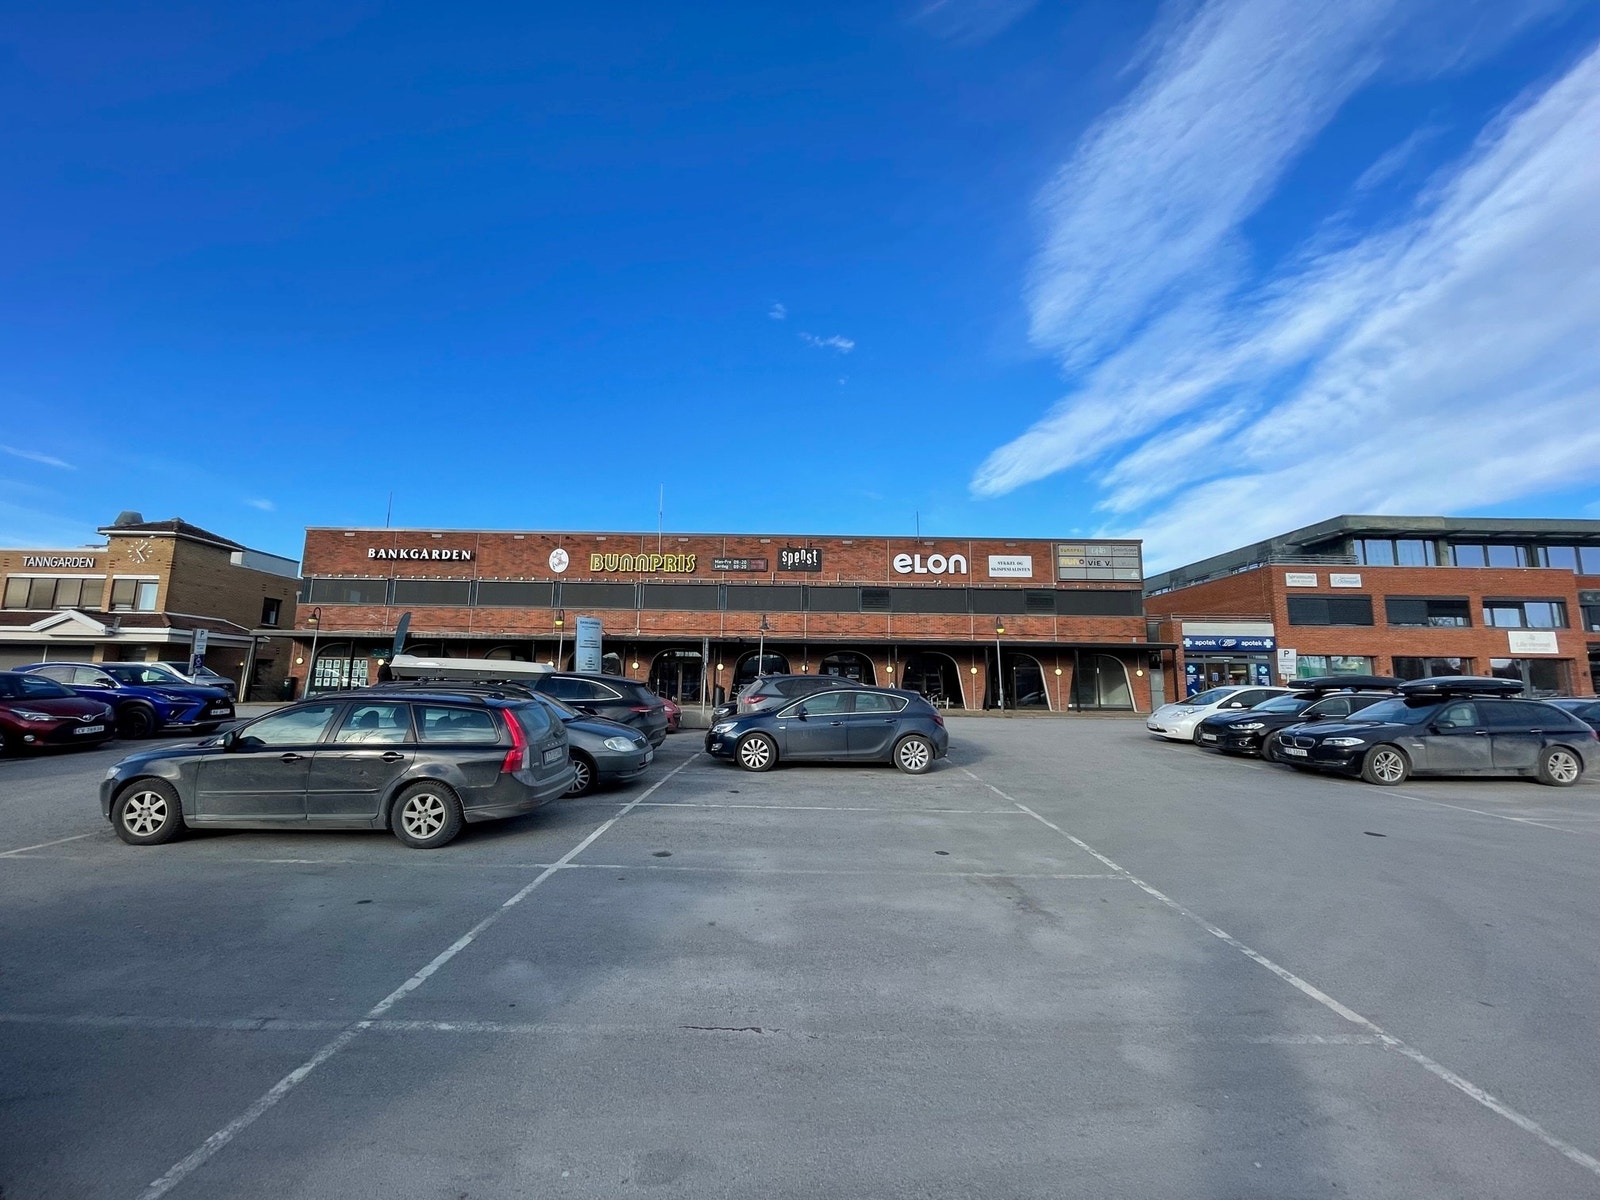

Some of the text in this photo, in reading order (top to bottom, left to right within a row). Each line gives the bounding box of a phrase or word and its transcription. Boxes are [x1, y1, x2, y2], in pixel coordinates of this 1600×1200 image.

[367, 548, 472, 560] BANKGARDEN
[22, 556, 95, 568] TANNGARDEN
[590, 553, 696, 573] BUNNPRIS
[1283, 650, 1290, 658] P
